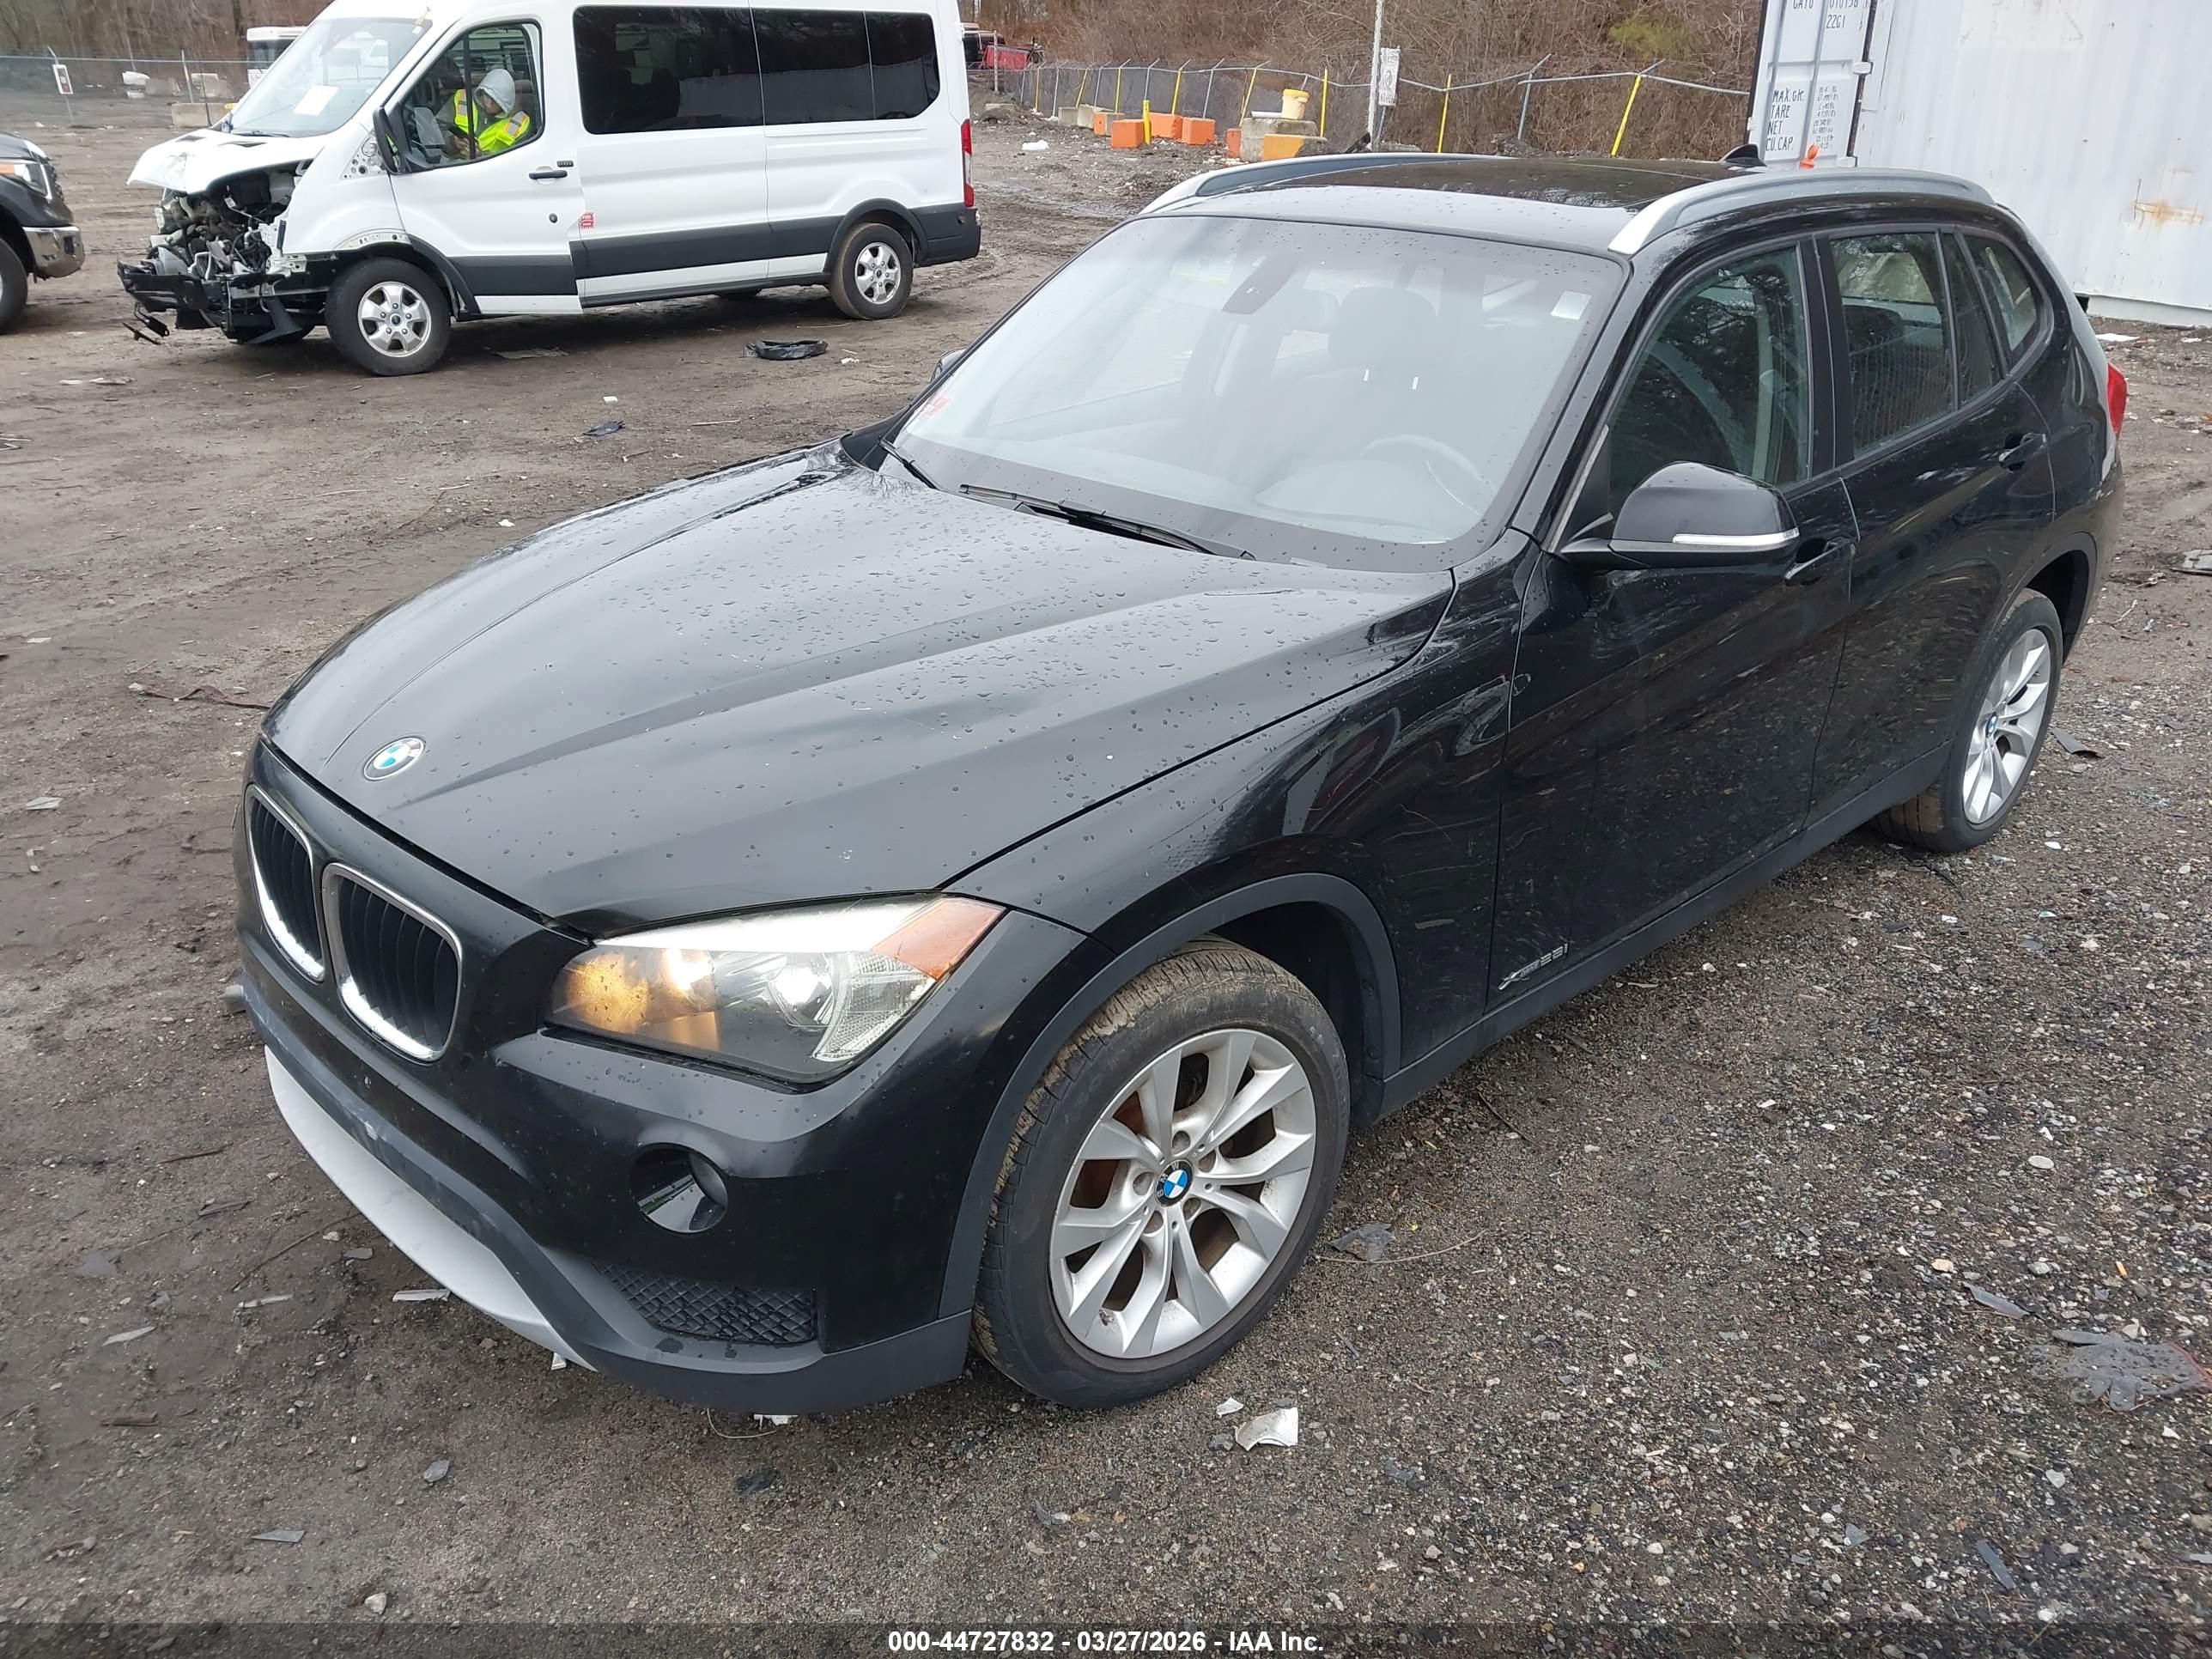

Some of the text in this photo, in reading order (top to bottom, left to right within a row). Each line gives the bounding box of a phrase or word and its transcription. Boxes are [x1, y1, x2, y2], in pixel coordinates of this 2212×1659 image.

[1826, 14, 1846, 29] 22G1
[1771, 104, 1790, 119] TARE
[1766, 119, 1784, 135] NET
